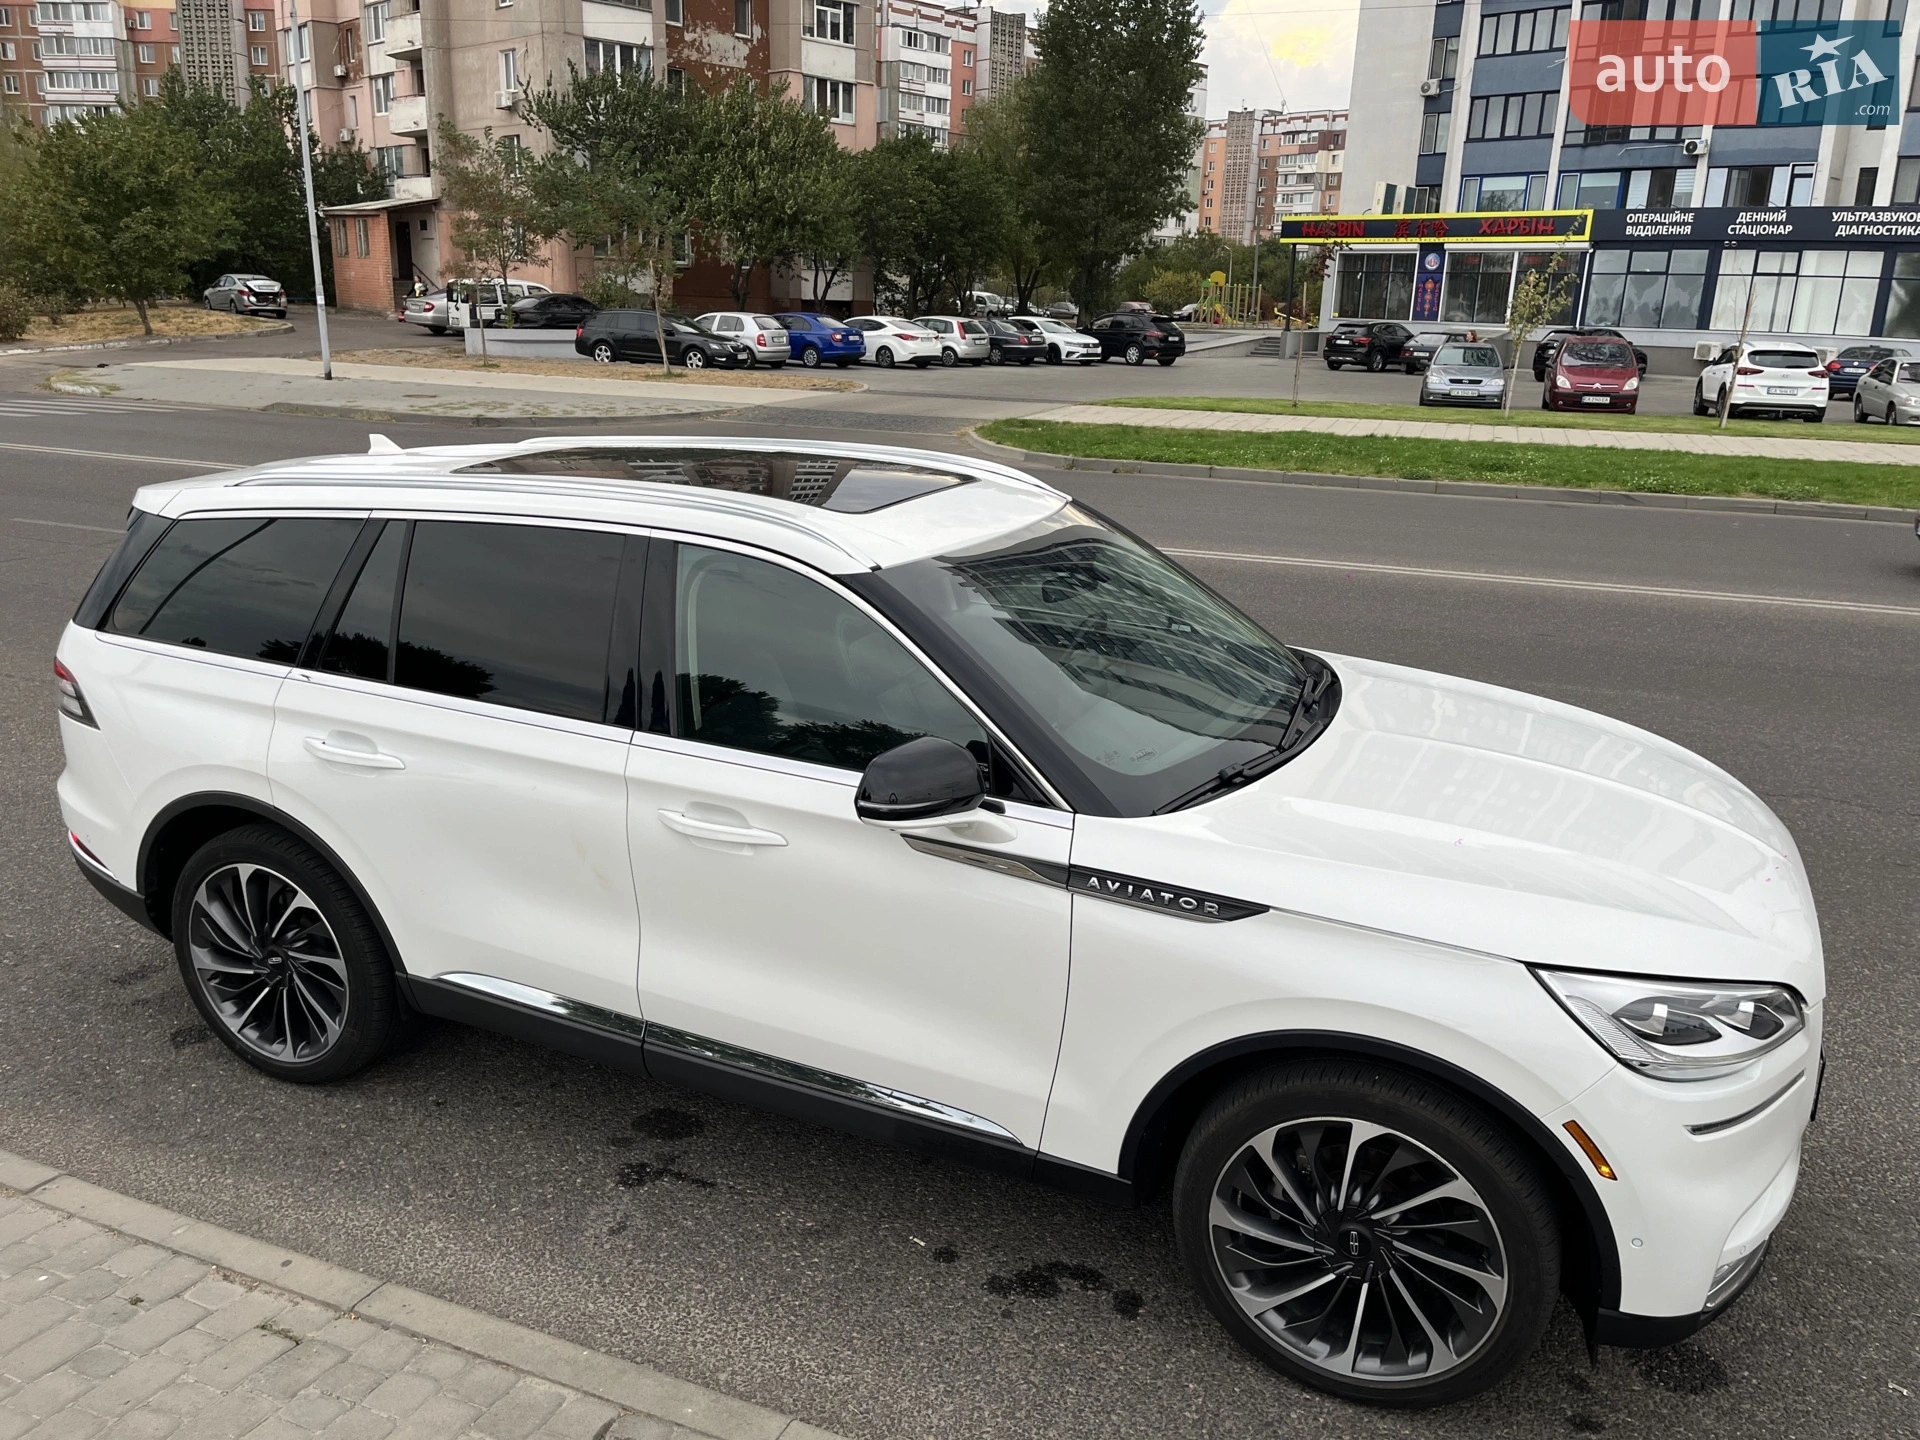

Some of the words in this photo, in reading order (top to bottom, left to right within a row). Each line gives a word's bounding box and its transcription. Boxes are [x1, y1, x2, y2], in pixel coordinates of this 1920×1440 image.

[1626, 210, 1695, 224] ОПЕРАЦІЙНЕ
[1736, 209, 1787, 224] ДЕННИЙ
[1302, 220, 1366, 237] HARBIN
[1625, 225, 1692, 237] ВІДДІЛЕННЯ
[1727, 224, 1793, 238] СТАЦІОНАР
[1086, 877, 1220, 915] AVIATOR
